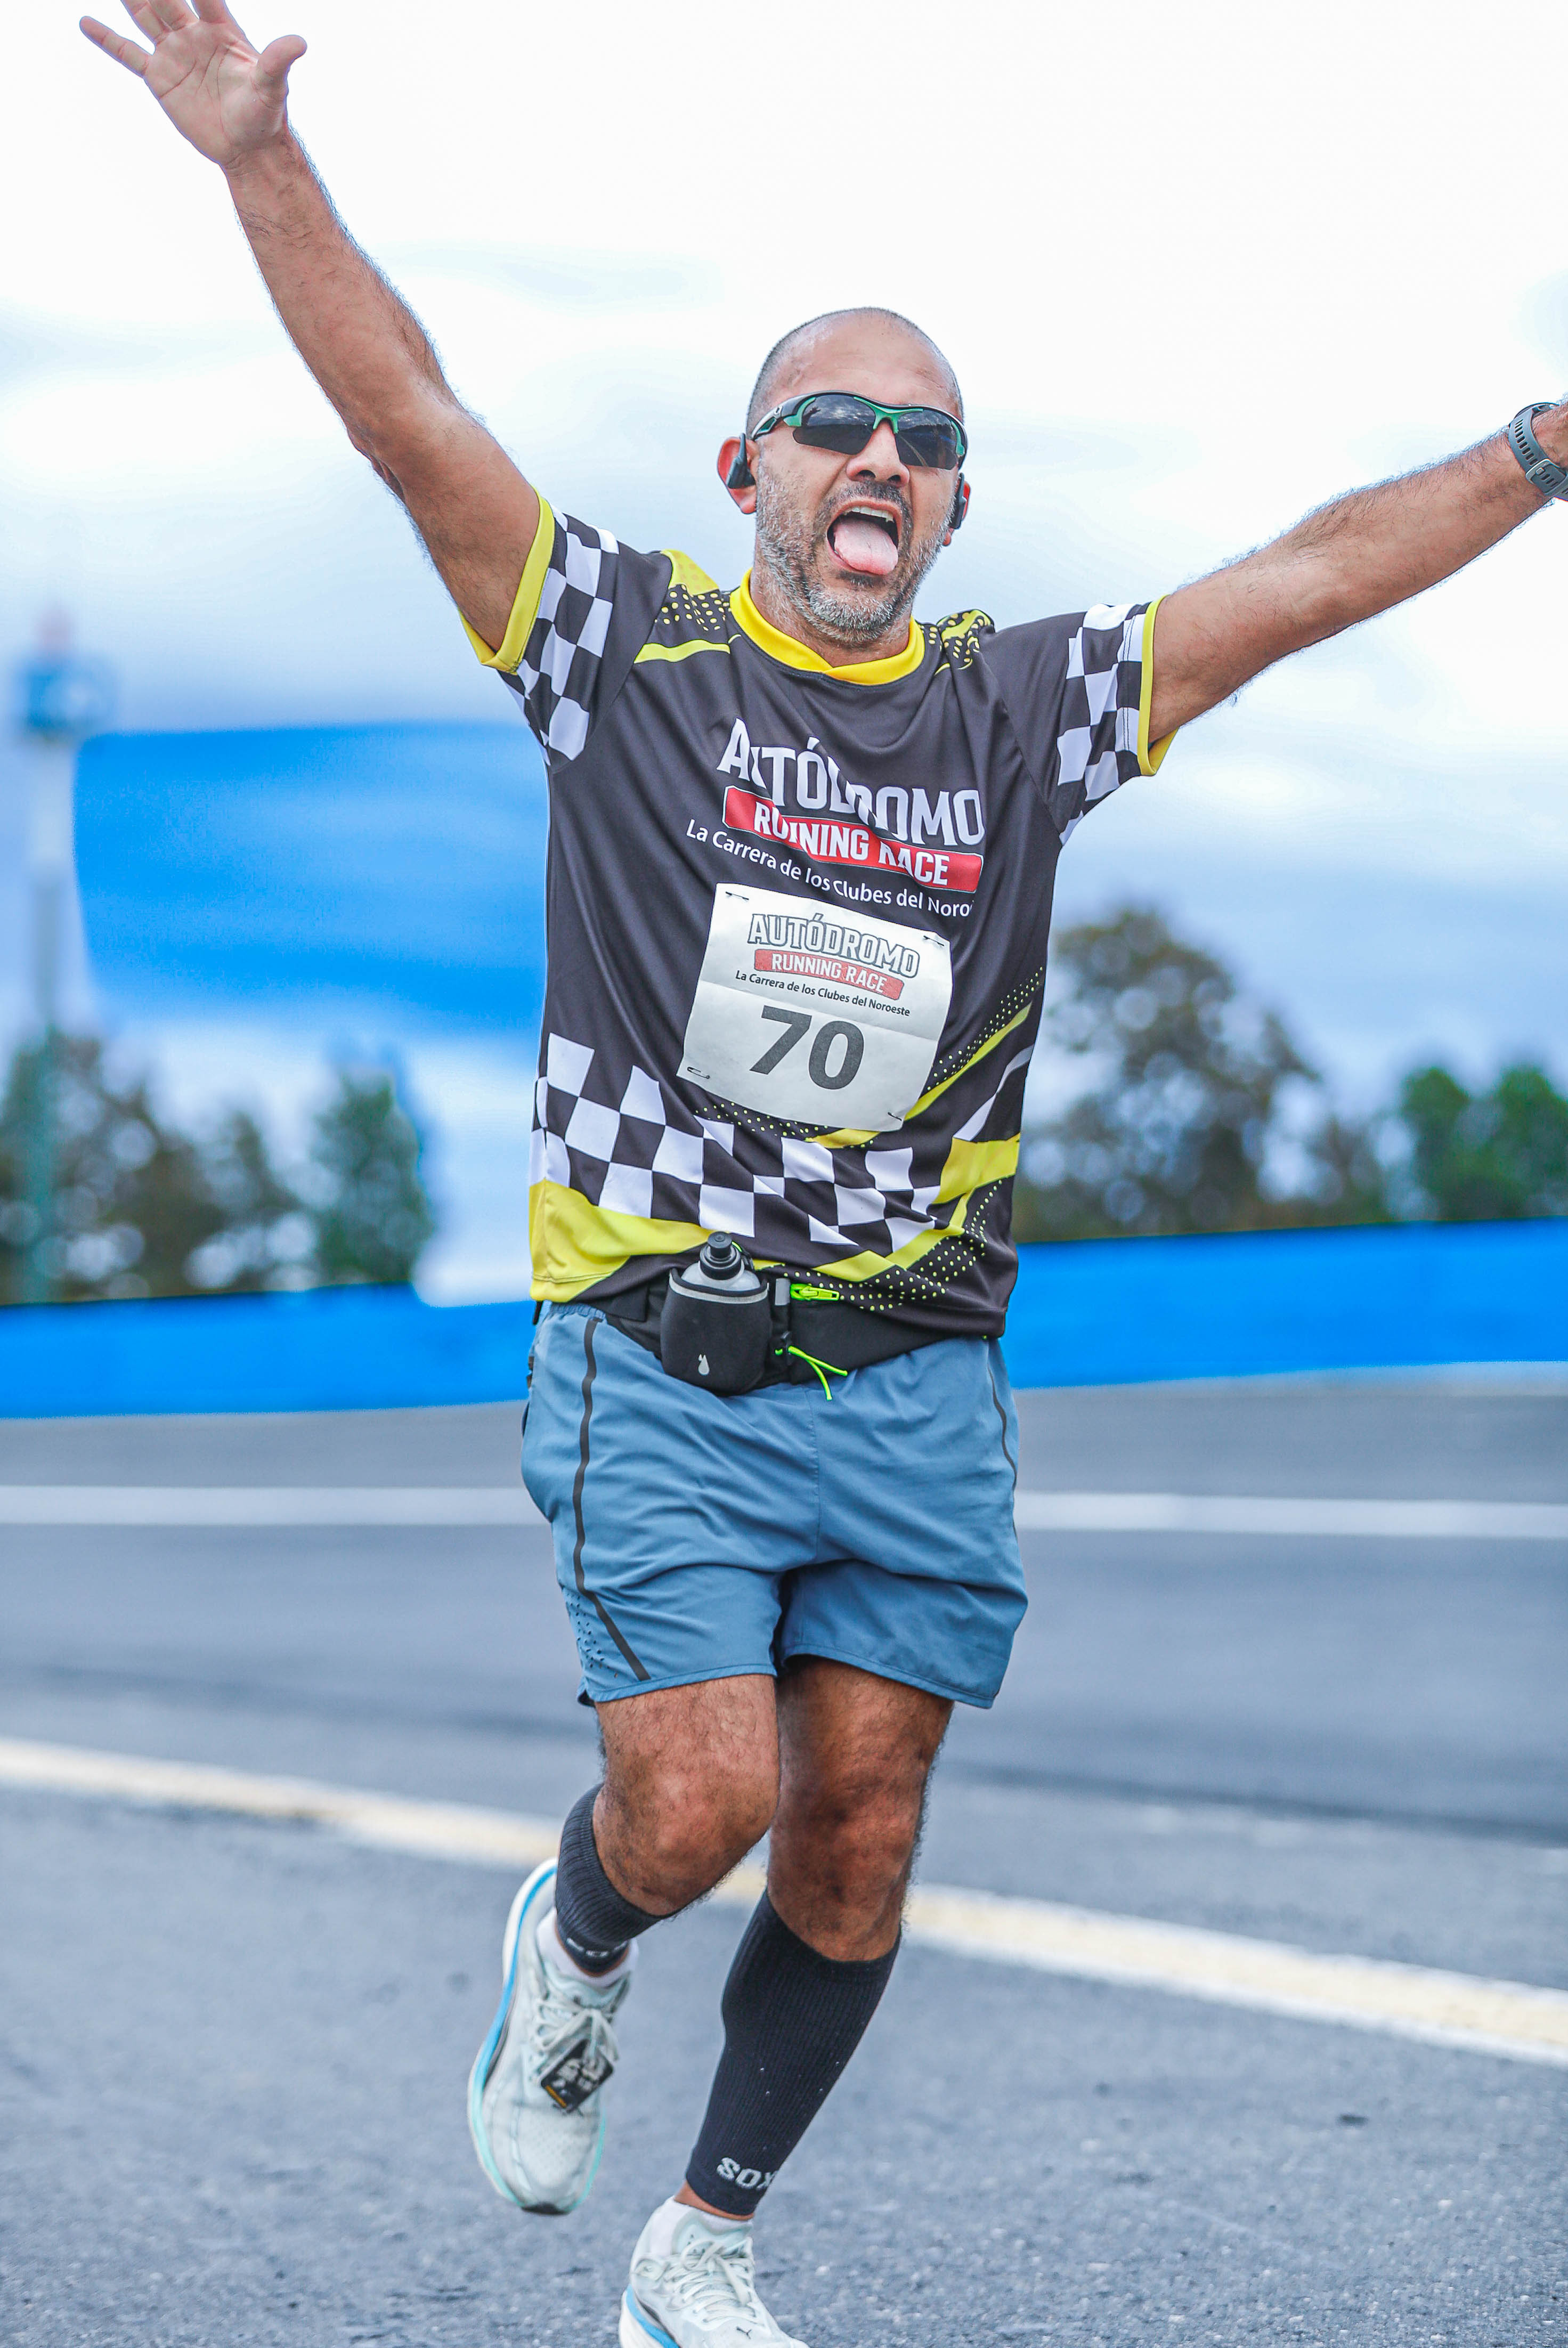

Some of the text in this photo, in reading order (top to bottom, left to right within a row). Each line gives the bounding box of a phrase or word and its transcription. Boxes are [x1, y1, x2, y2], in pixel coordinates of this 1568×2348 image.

[686, 819, 974, 917] La Carrera de los Clubes del Noro
[747, 913, 920, 978] AUTÓDROMO
[772, 953, 888, 994] RUNNING RACE
[735, 970, 911, 1017] La Carrera de los Clubes del Noroeste
[750, 1005, 864, 1090] 70
